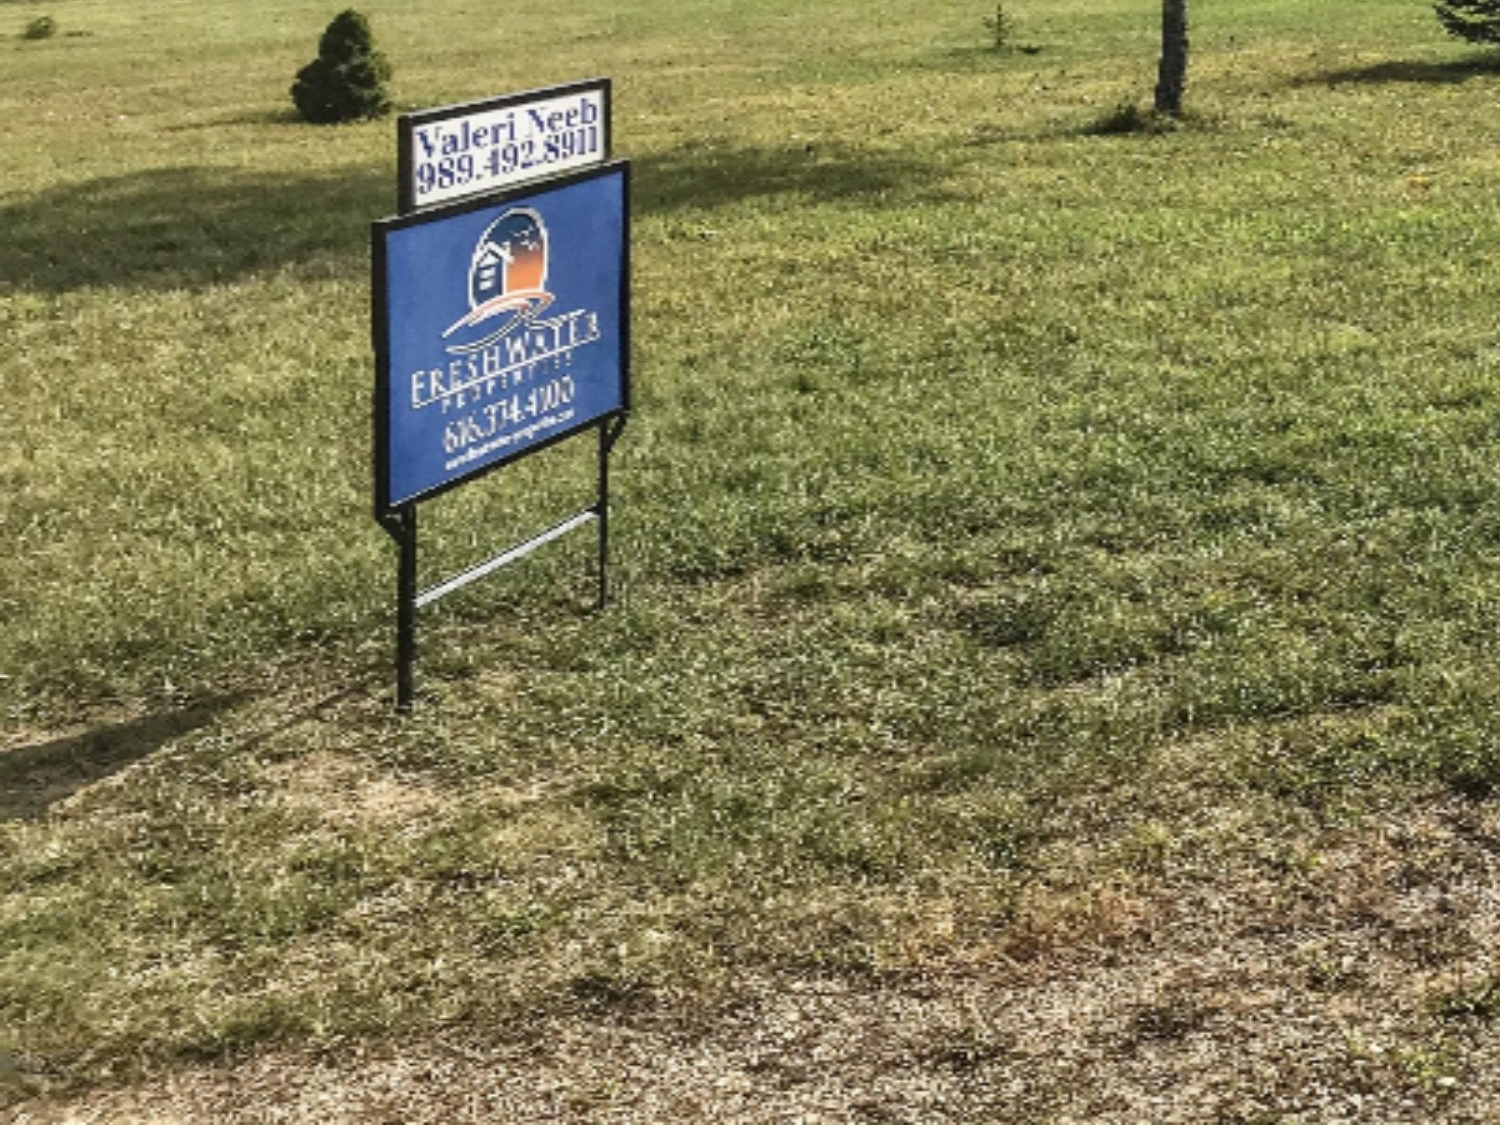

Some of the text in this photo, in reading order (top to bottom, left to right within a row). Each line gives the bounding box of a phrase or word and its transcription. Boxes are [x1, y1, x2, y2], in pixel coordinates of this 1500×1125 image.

[416, 98, 598, 158] Valeri Neeb
[416, 126, 598, 194] 989.492.8911
